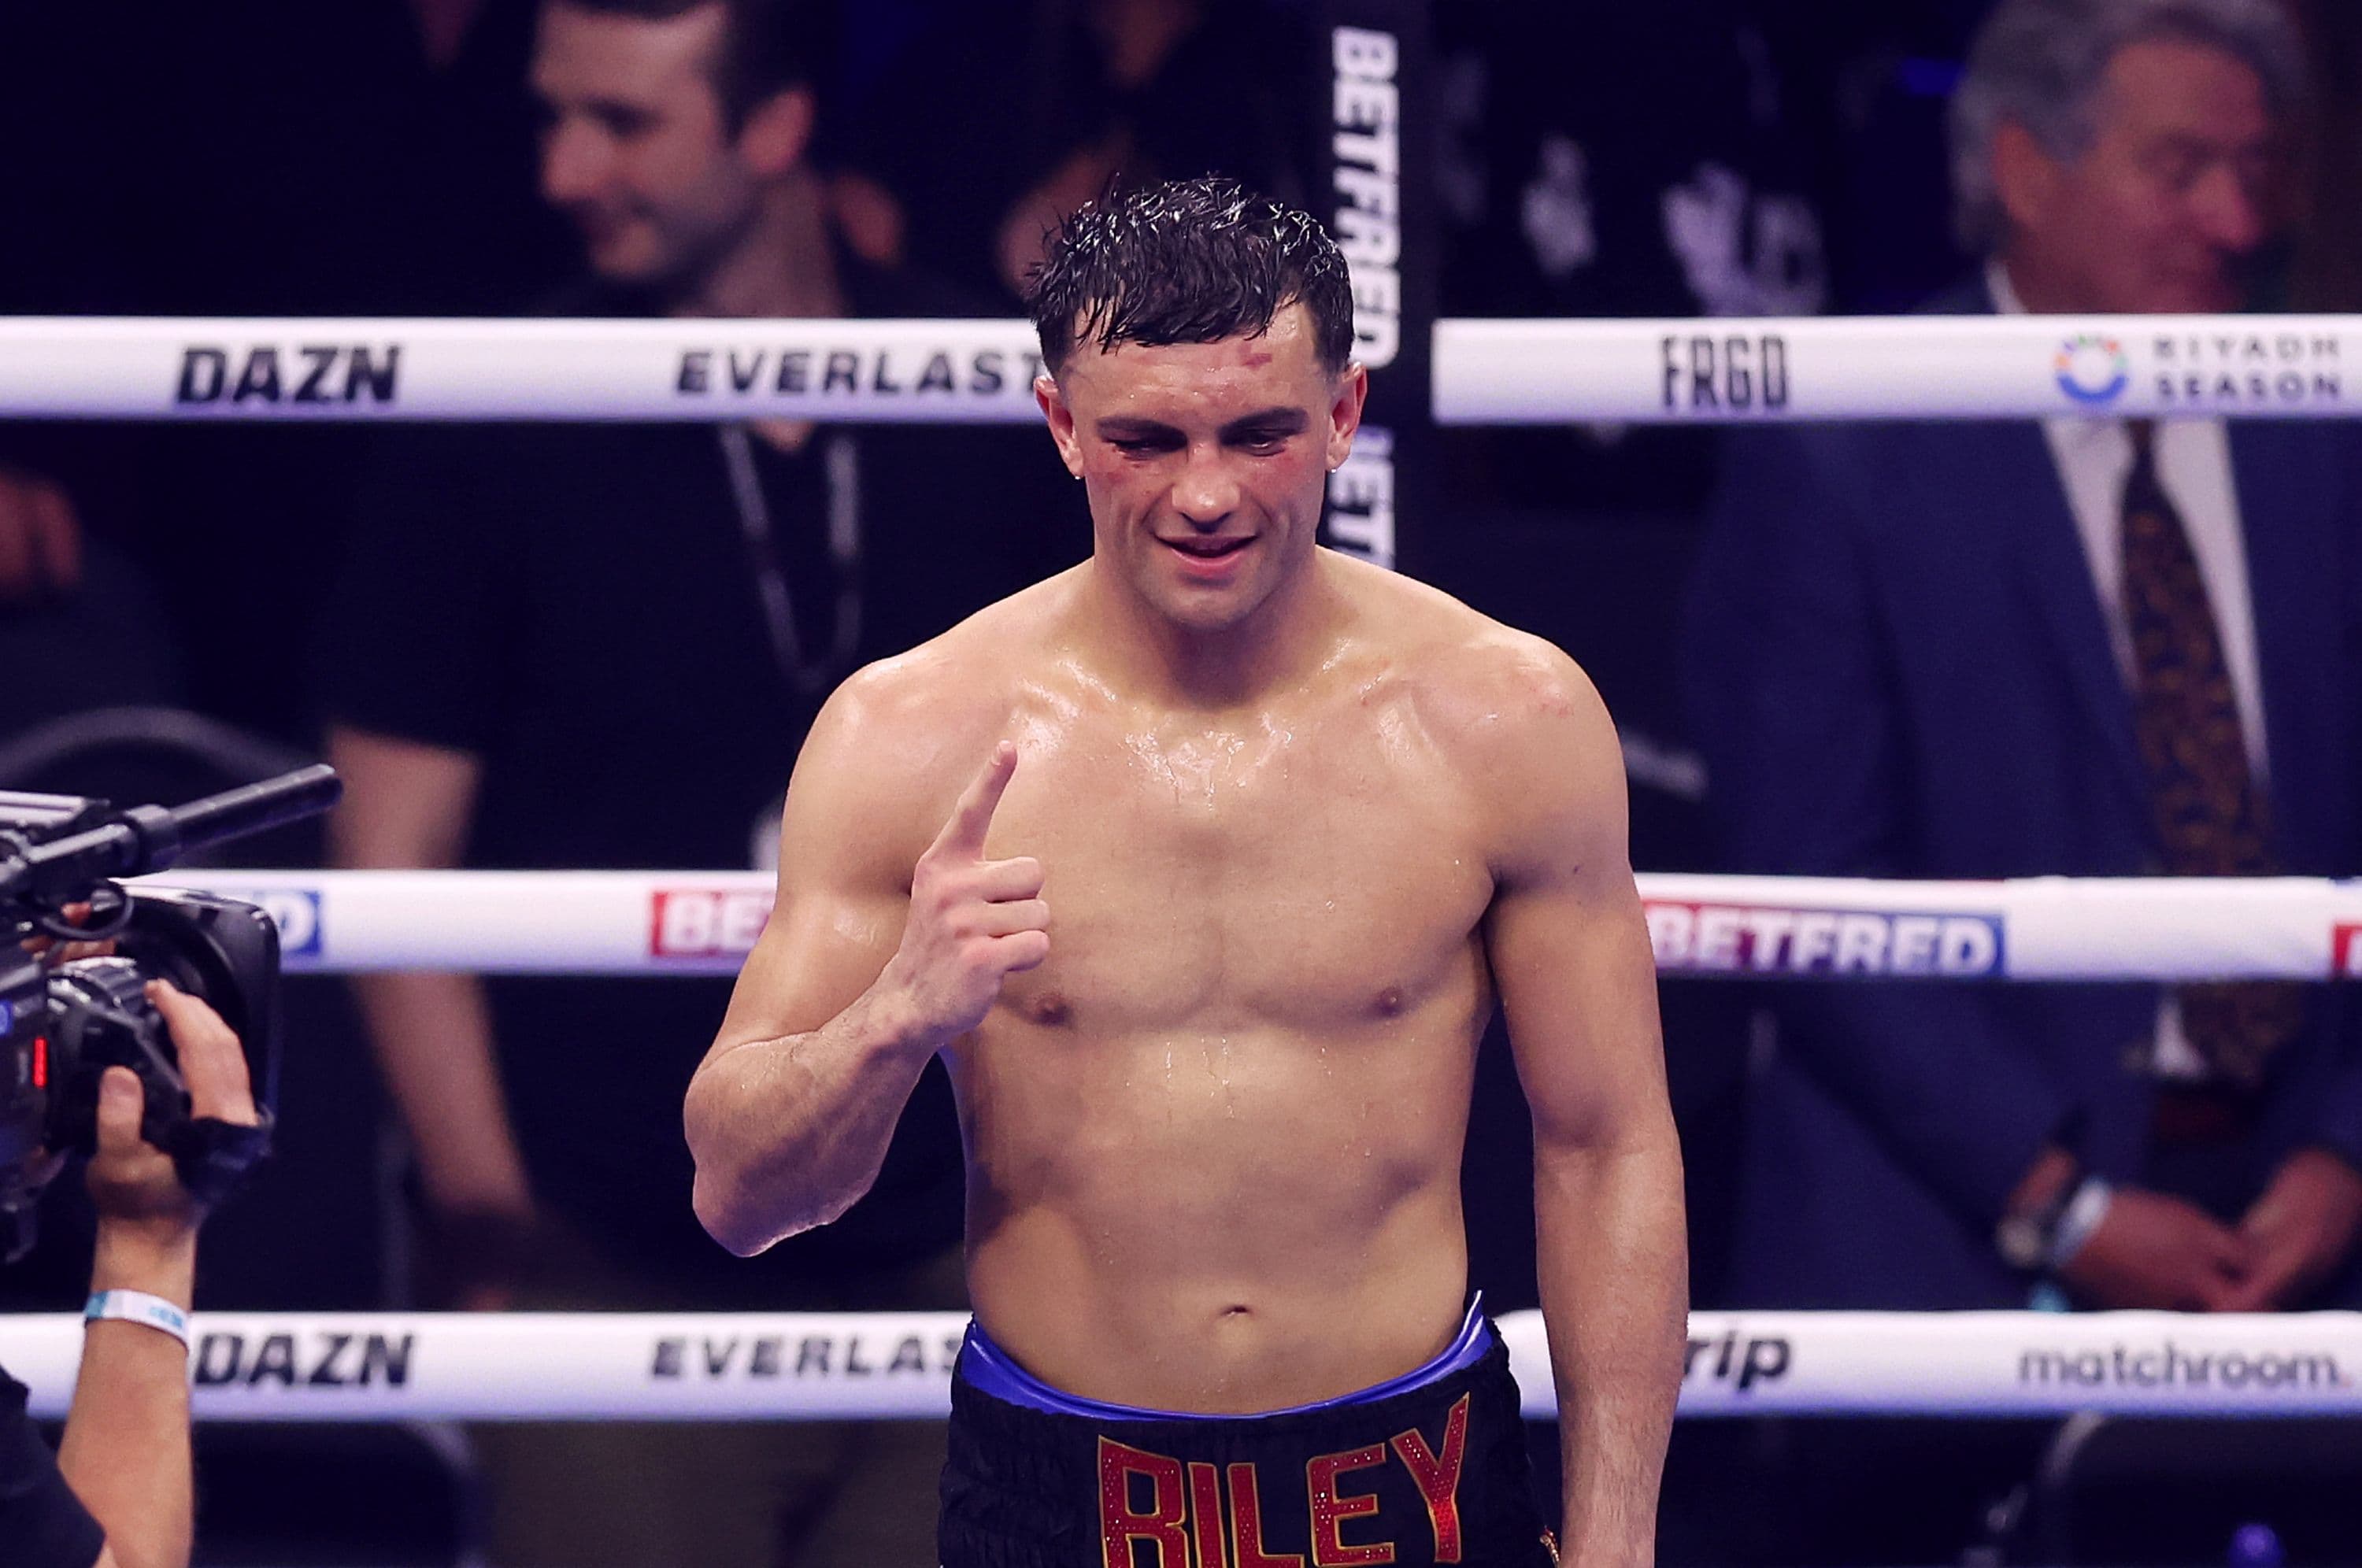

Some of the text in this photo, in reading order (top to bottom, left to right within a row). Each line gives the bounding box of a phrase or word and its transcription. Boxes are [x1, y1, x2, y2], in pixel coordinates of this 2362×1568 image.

[1333, 26, 1401, 369] BETFRED
[178, 345, 402, 404] DAZN
[676, 349, 1042, 394] EVERLAST
[2153, 336, 2339, 358] RIYADH
[2155, 374, 2339, 398] SEASON
[1648, 905, 1998, 976] BETFRED
[194, 1334, 413, 1385] DAZN
[1098, 1391, 1470, 1568] RILEY
